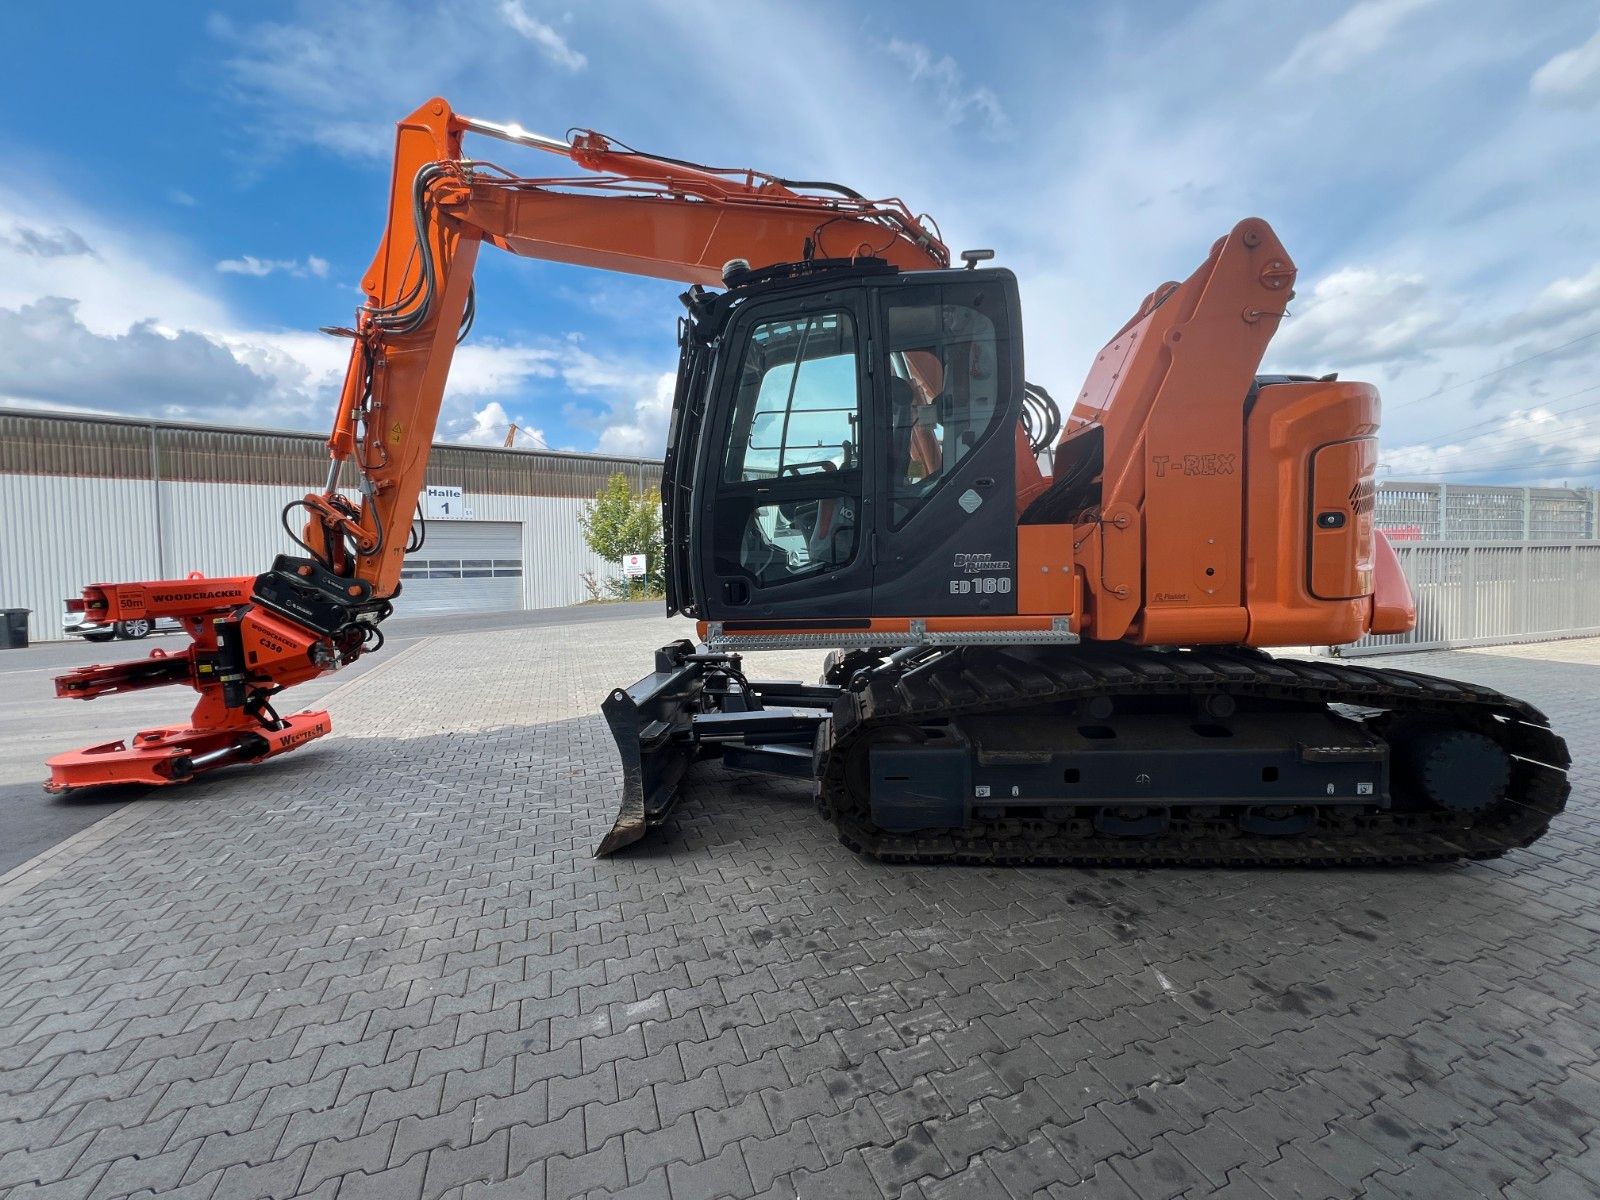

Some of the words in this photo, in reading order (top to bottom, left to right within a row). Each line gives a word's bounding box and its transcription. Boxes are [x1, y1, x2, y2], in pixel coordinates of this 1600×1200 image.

[1152, 453, 1236, 477] T-REX
[428, 489, 461, 498] Halle
[441, 502, 450, 515] 1
[964, 561, 1011, 574] RUNNER
[971, 577, 1011, 594] 160
[152, 590, 242, 602] WOODCRACKER
[120, 599, 144, 609] 50m
[251, 623, 298, 649] WOODCRACKER
[260, 638, 283, 653] C350
